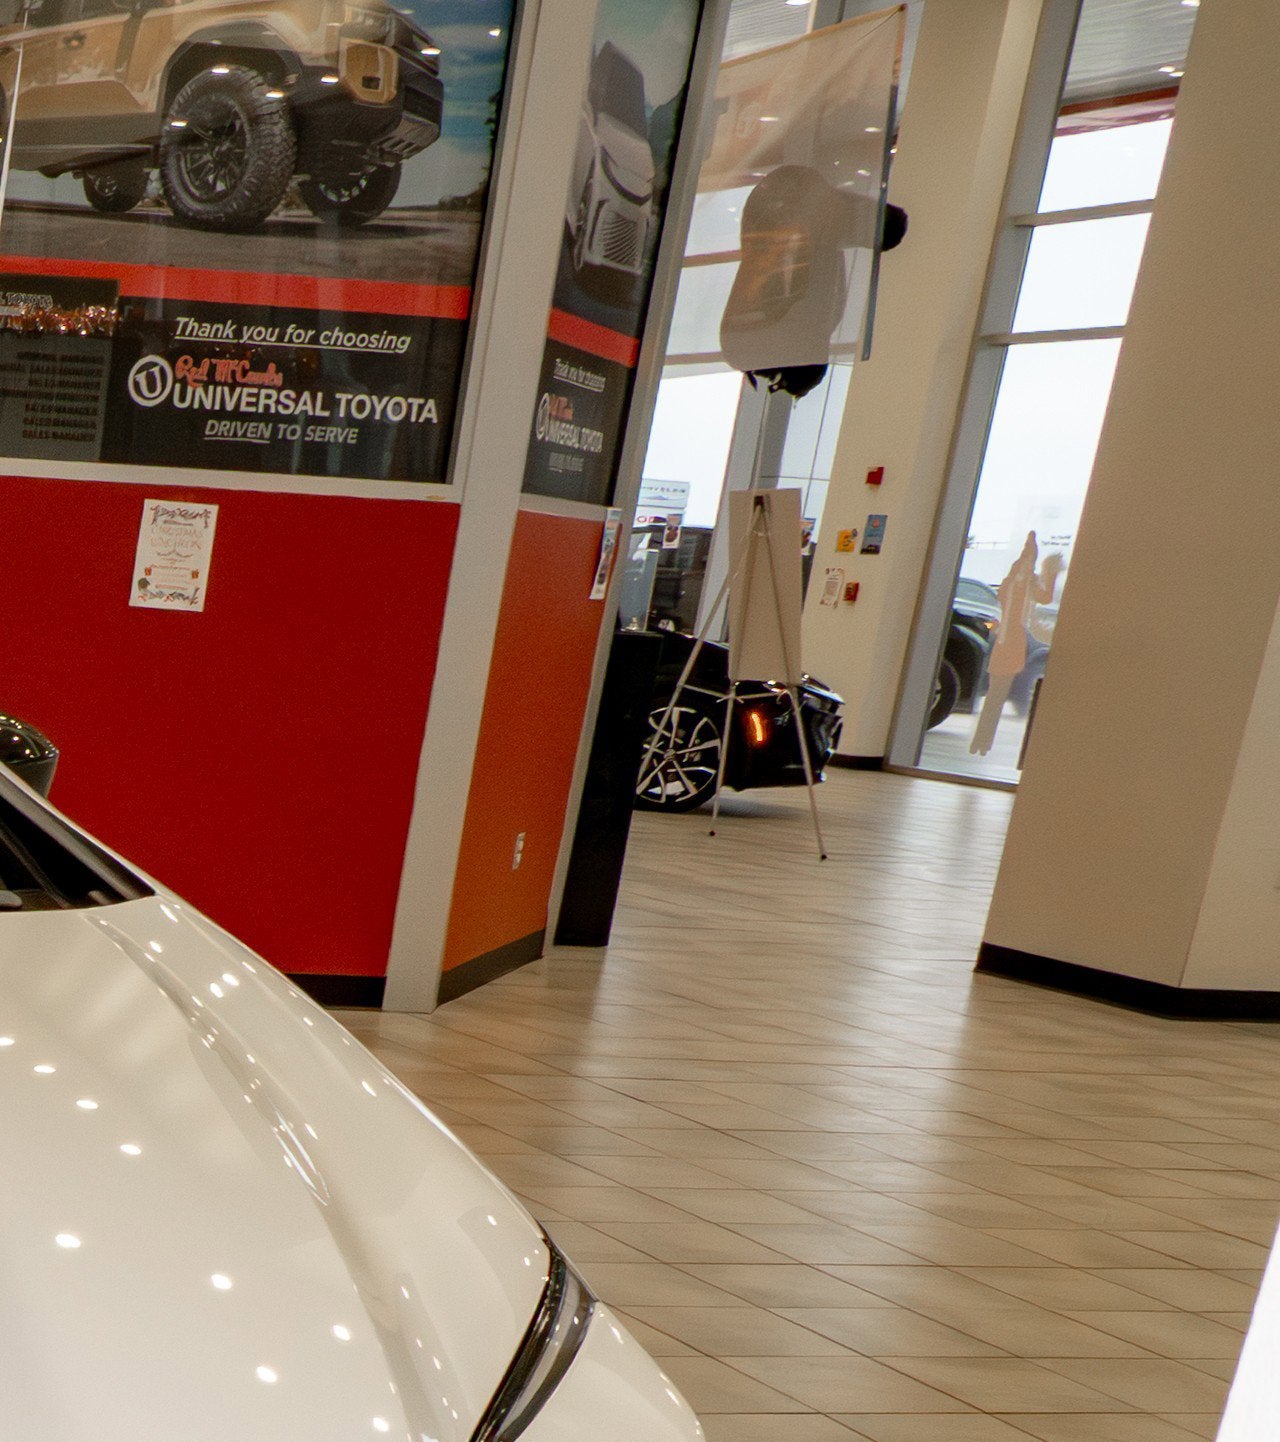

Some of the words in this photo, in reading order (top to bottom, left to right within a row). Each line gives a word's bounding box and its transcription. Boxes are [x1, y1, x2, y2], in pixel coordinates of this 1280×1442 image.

[175, 317, 237, 339] Thank
[241, 325, 280, 343] you
[284, 324, 315, 343] for
[319, 327, 412, 353] choosing
[175, 355, 209, 388] Red
[173, 383, 330, 417] UNIVERSAL
[335, 393, 438, 423] TOYOTA
[205, 419, 272, 439] DRIVEN
[277, 423, 300, 440] TO
[304, 426, 359, 444] SERVE
